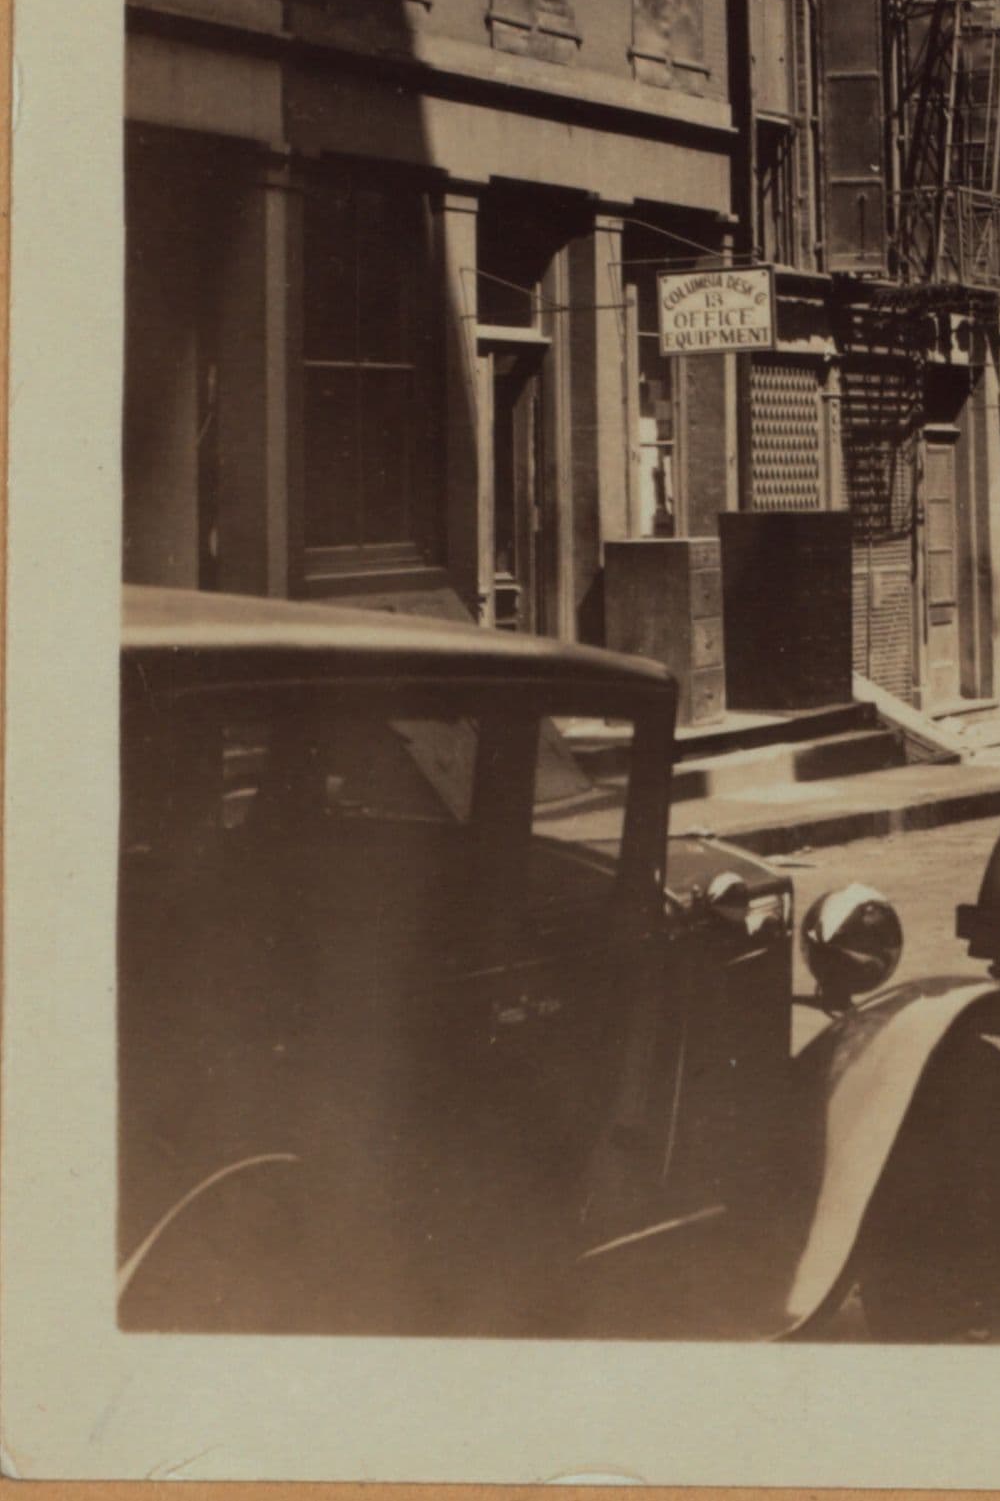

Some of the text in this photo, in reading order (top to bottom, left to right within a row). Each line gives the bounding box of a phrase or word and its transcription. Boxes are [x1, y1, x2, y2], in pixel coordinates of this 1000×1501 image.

[663, 274, 723, 311] COLUMBIA
[727, 274, 754, 296] DESK
[673, 306, 754, 329] OFFICE
[665, 326, 769, 349] EQUIPMENT
